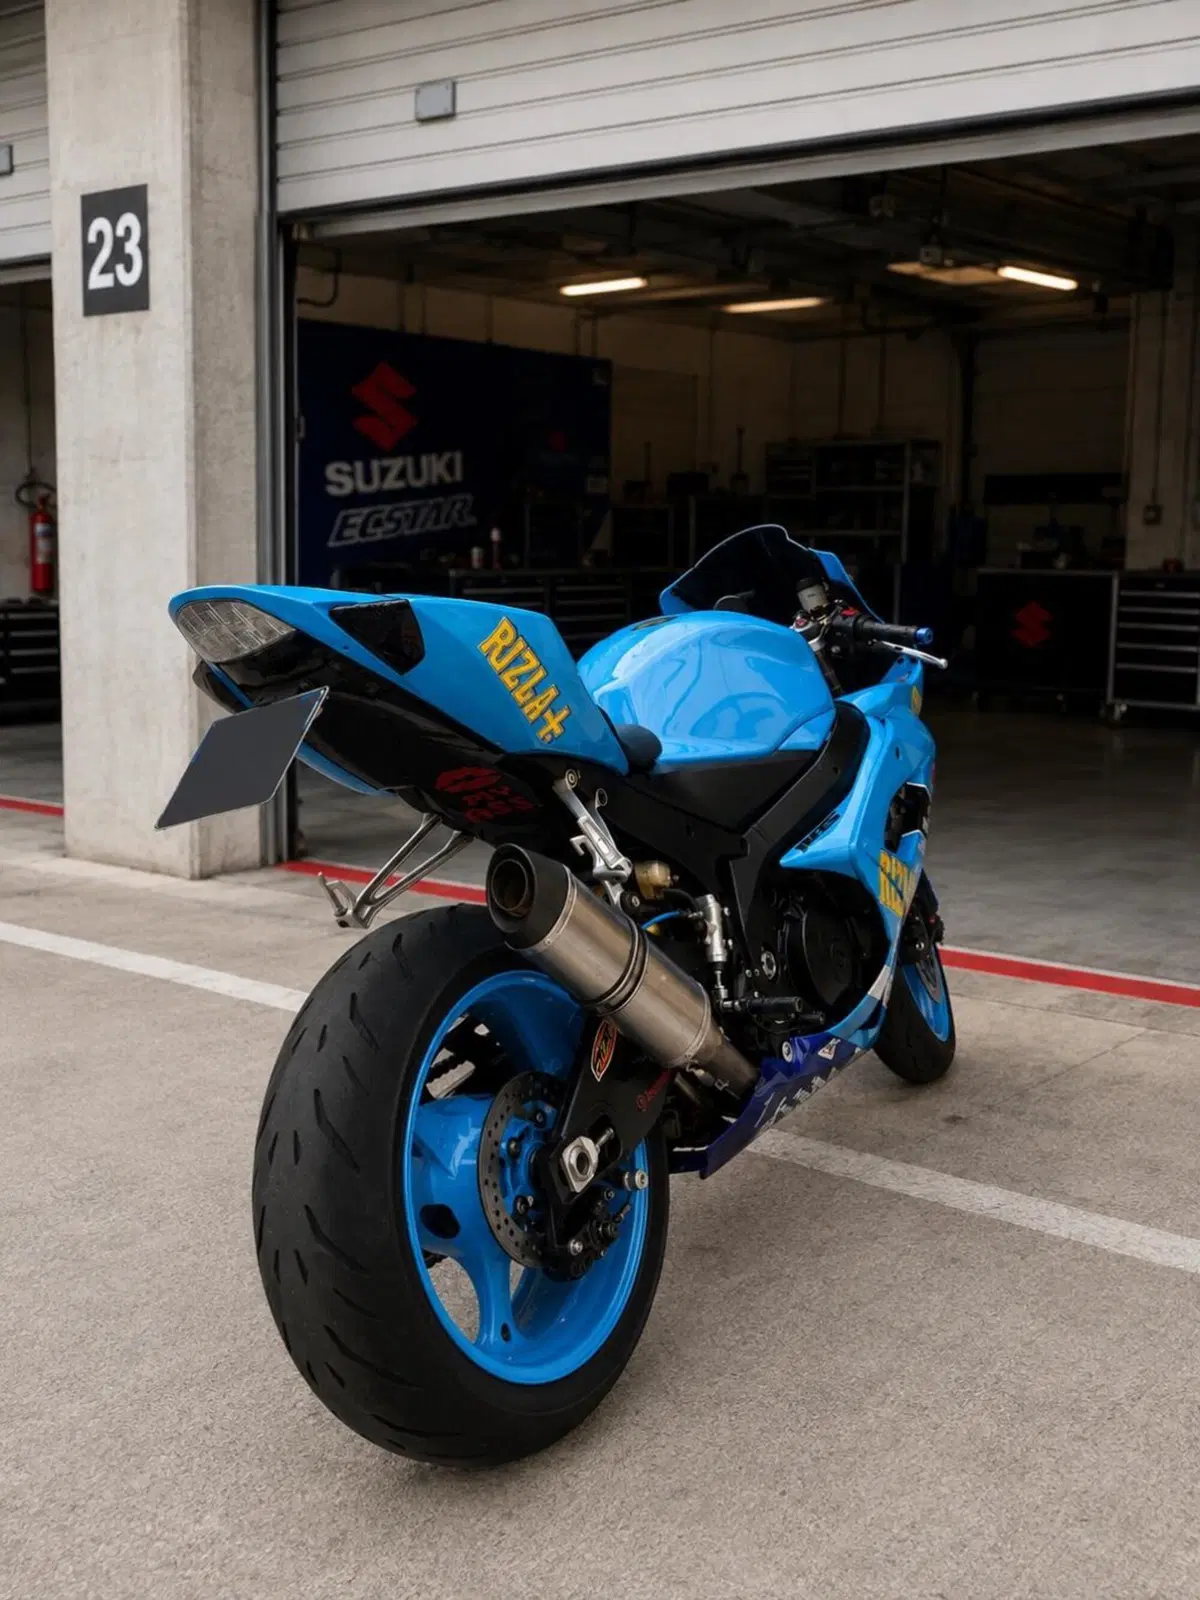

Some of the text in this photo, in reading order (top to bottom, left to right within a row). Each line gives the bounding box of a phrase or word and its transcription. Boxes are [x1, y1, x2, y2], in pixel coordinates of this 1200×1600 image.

[88, 212, 143, 290] 23
[325, 451, 463, 497] SUZUKI
[328, 493, 478, 547] ECSTAR
[477, 616, 571, 744] RIZLA+
